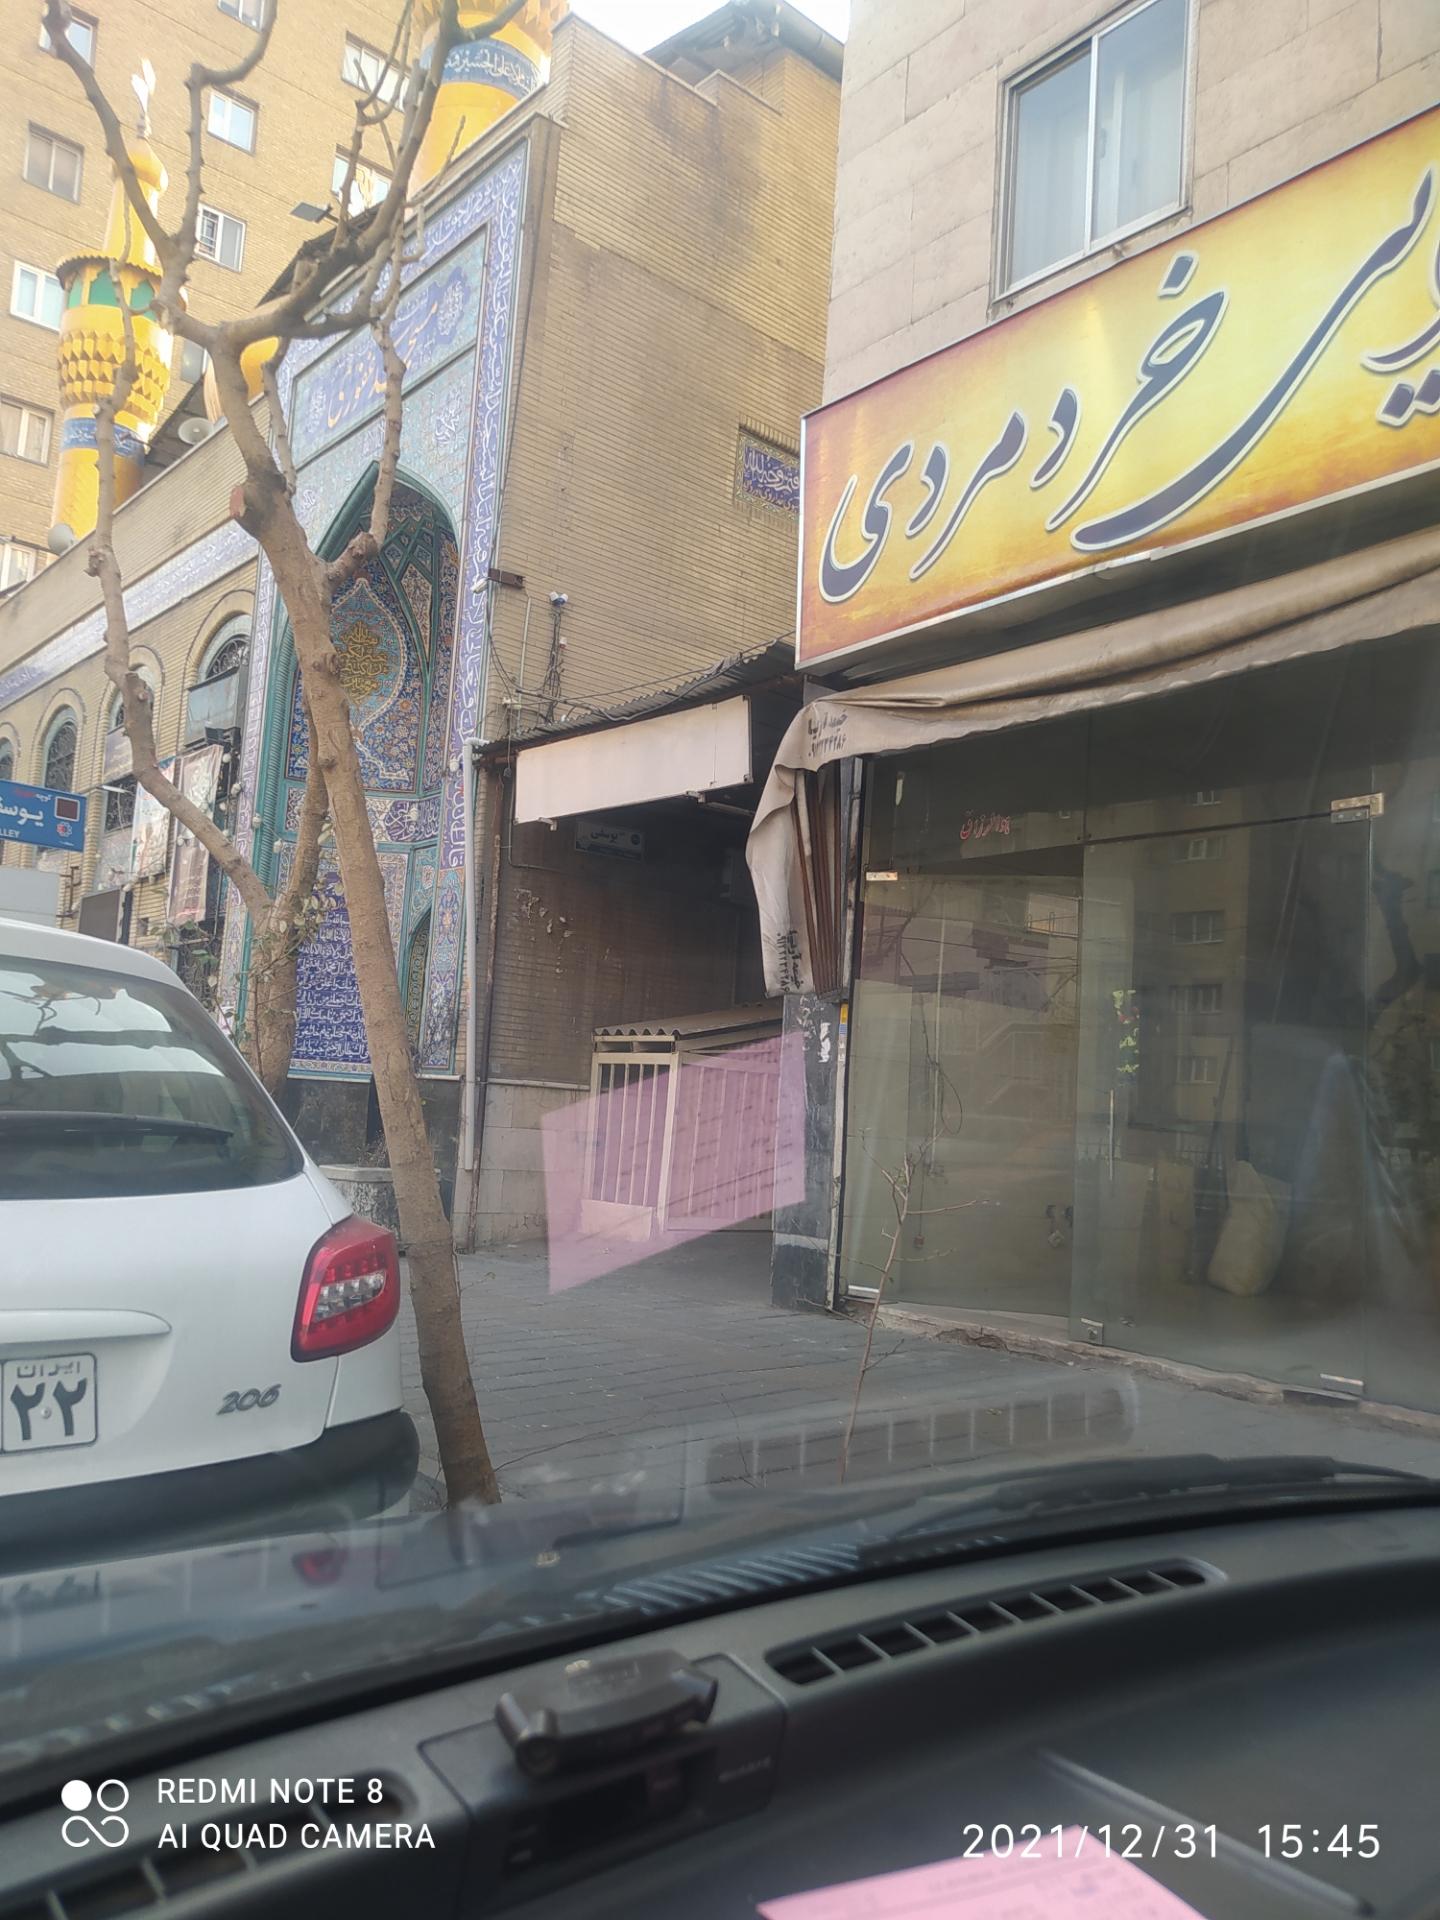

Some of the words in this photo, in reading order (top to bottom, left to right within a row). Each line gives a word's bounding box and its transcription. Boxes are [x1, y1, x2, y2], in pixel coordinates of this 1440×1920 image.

[16, 1361, 80, 1379] ایران
[10, 1377, 87, 1441] ۲۲
[215, 1383, 282, 1416] 206
